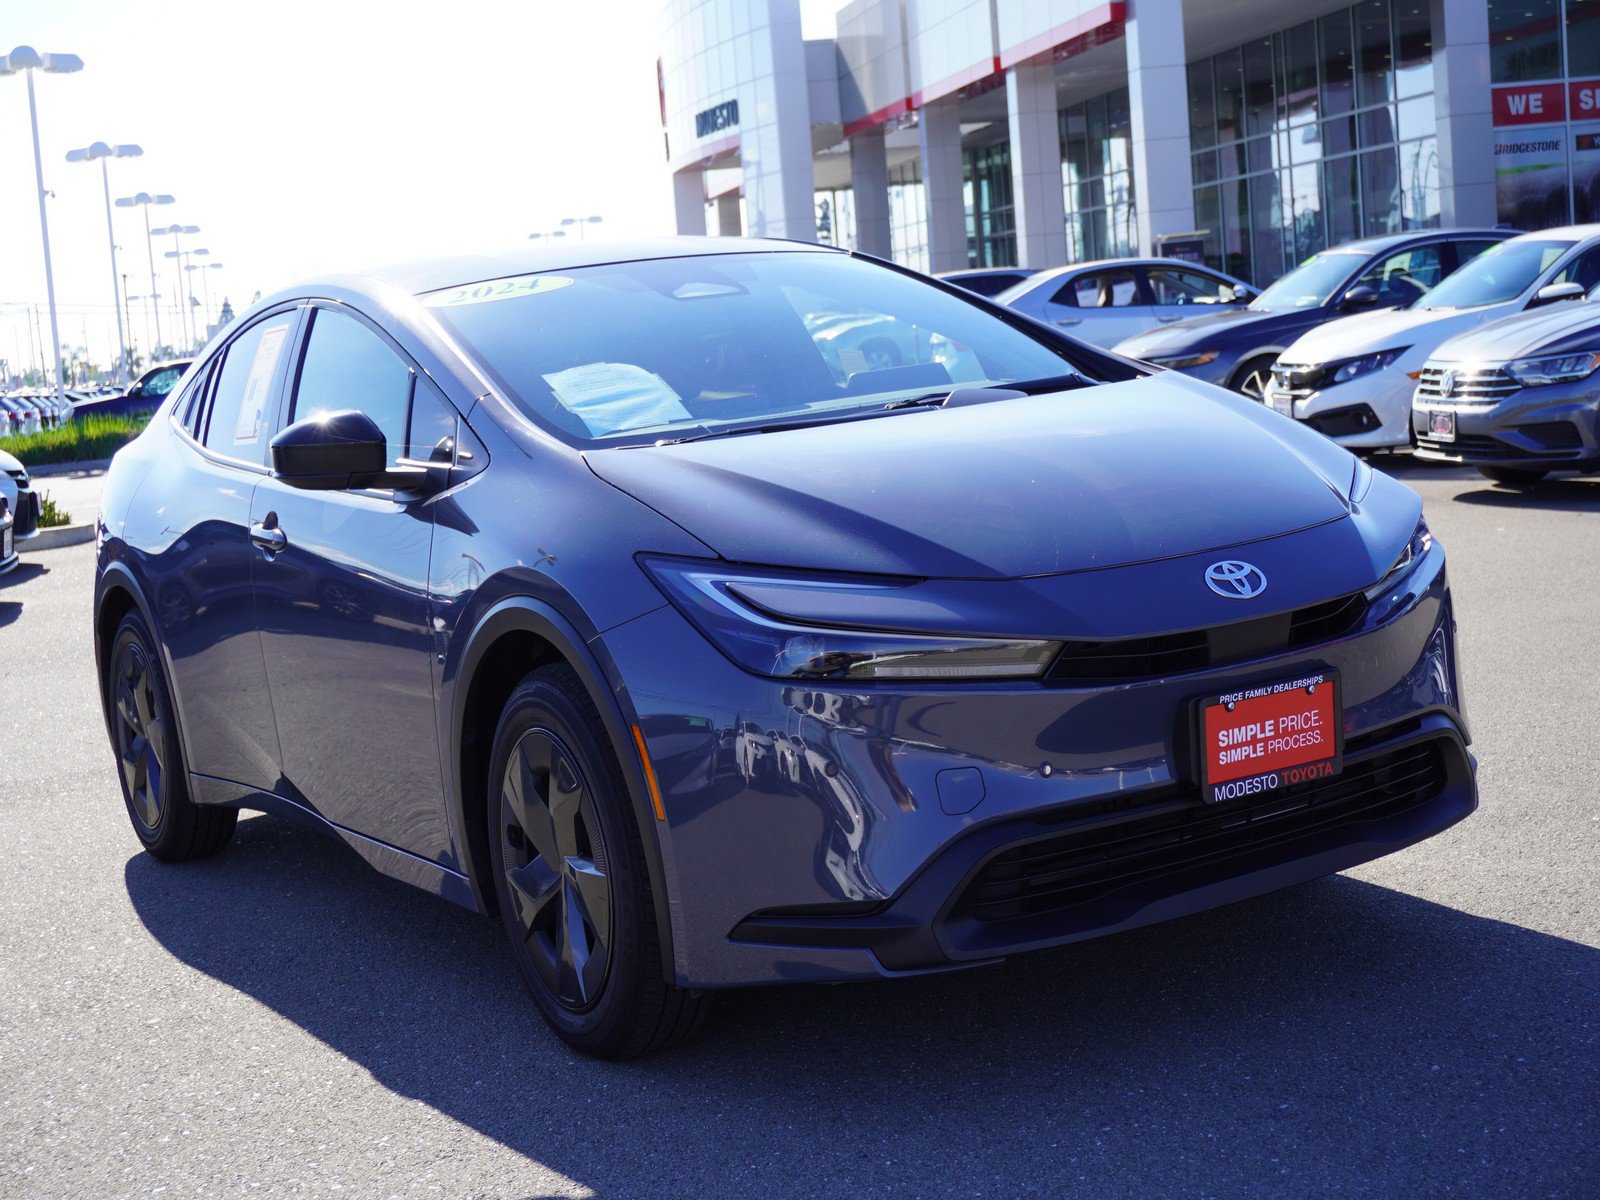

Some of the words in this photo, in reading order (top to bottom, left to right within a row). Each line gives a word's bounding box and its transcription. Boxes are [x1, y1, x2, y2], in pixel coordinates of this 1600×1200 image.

[1507, 93, 1543, 115] WE
[1494, 140, 1561, 155] BRIDGESTONE
[449, 278, 540, 303] 2024
[1219, 692, 1243, 704] PRICE
[1245, 686, 1273, 700] FAMILY
[1273, 675, 1323, 692] DEALERSHIPS
[1218, 720, 1274, 747] SIMPLE
[1279, 710, 1323, 733] PRICE.
[1219, 742, 1264, 765] SIMPLE
[1268, 730, 1323, 754] PROCESS.
[1214, 774, 1278, 801] MODESTO
[1281, 762, 1333, 784] TOYOTA
